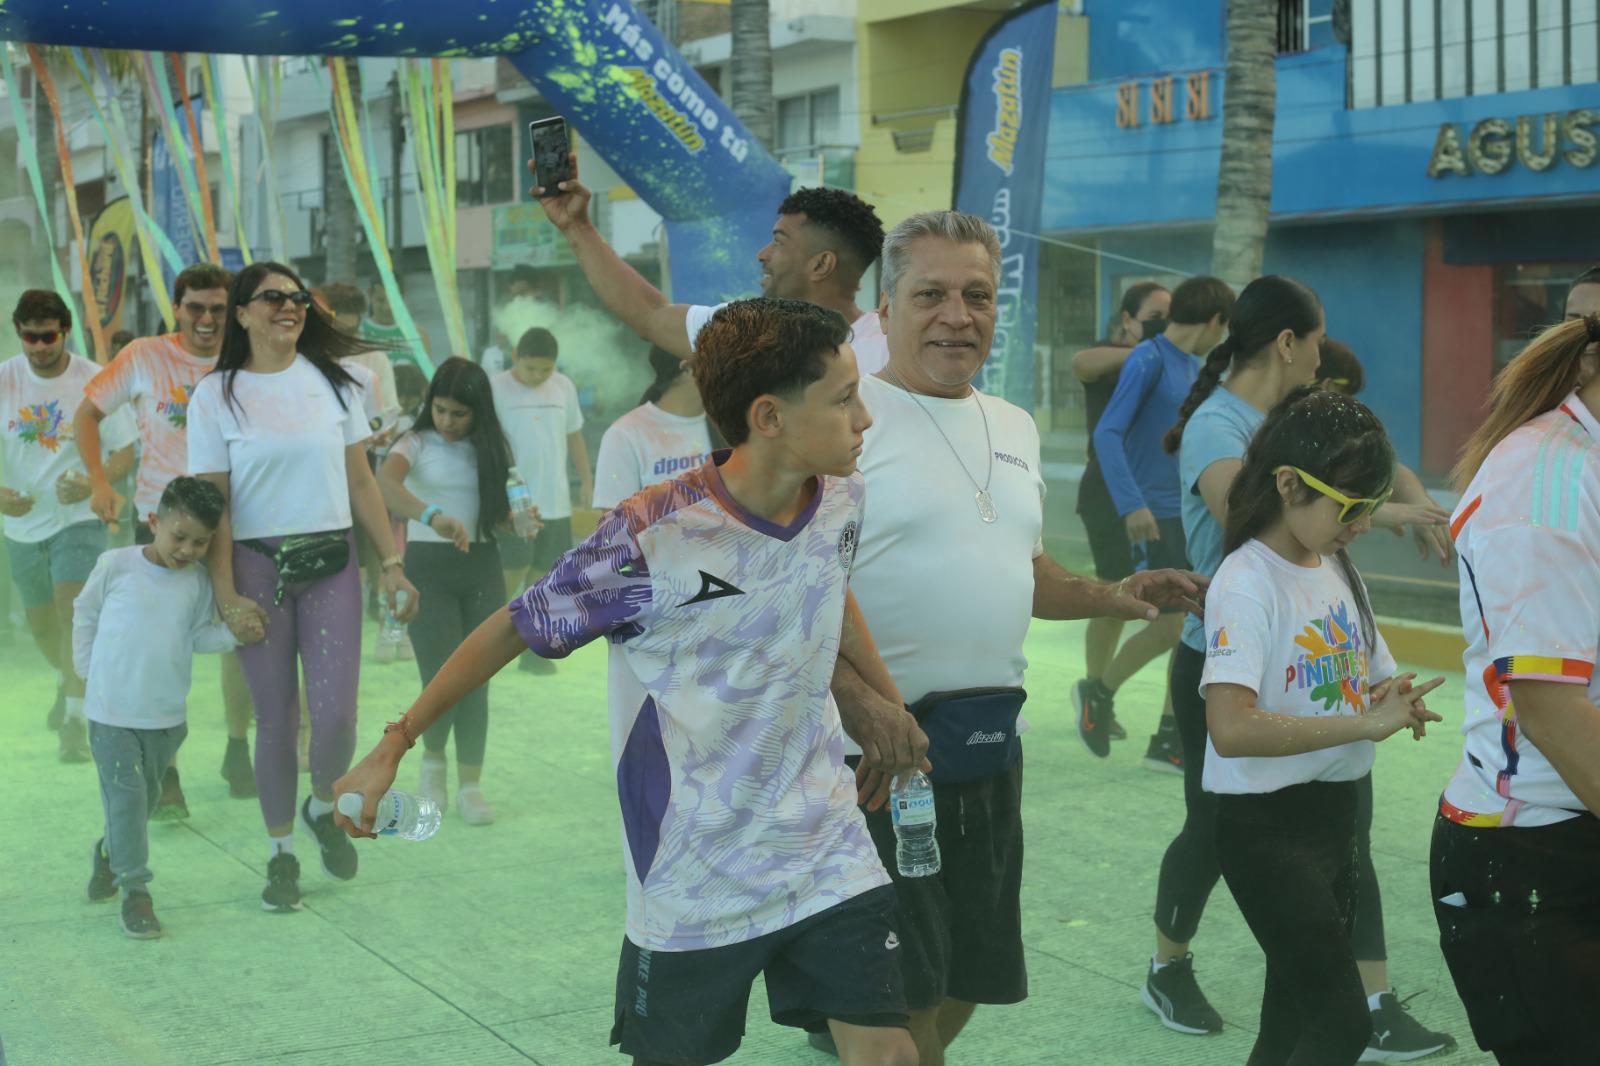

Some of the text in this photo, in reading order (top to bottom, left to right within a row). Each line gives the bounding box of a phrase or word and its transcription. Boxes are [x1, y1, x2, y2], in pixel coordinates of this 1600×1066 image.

[604, 3, 748, 163] Más como tú
[653, 453, 709, 475] dport
